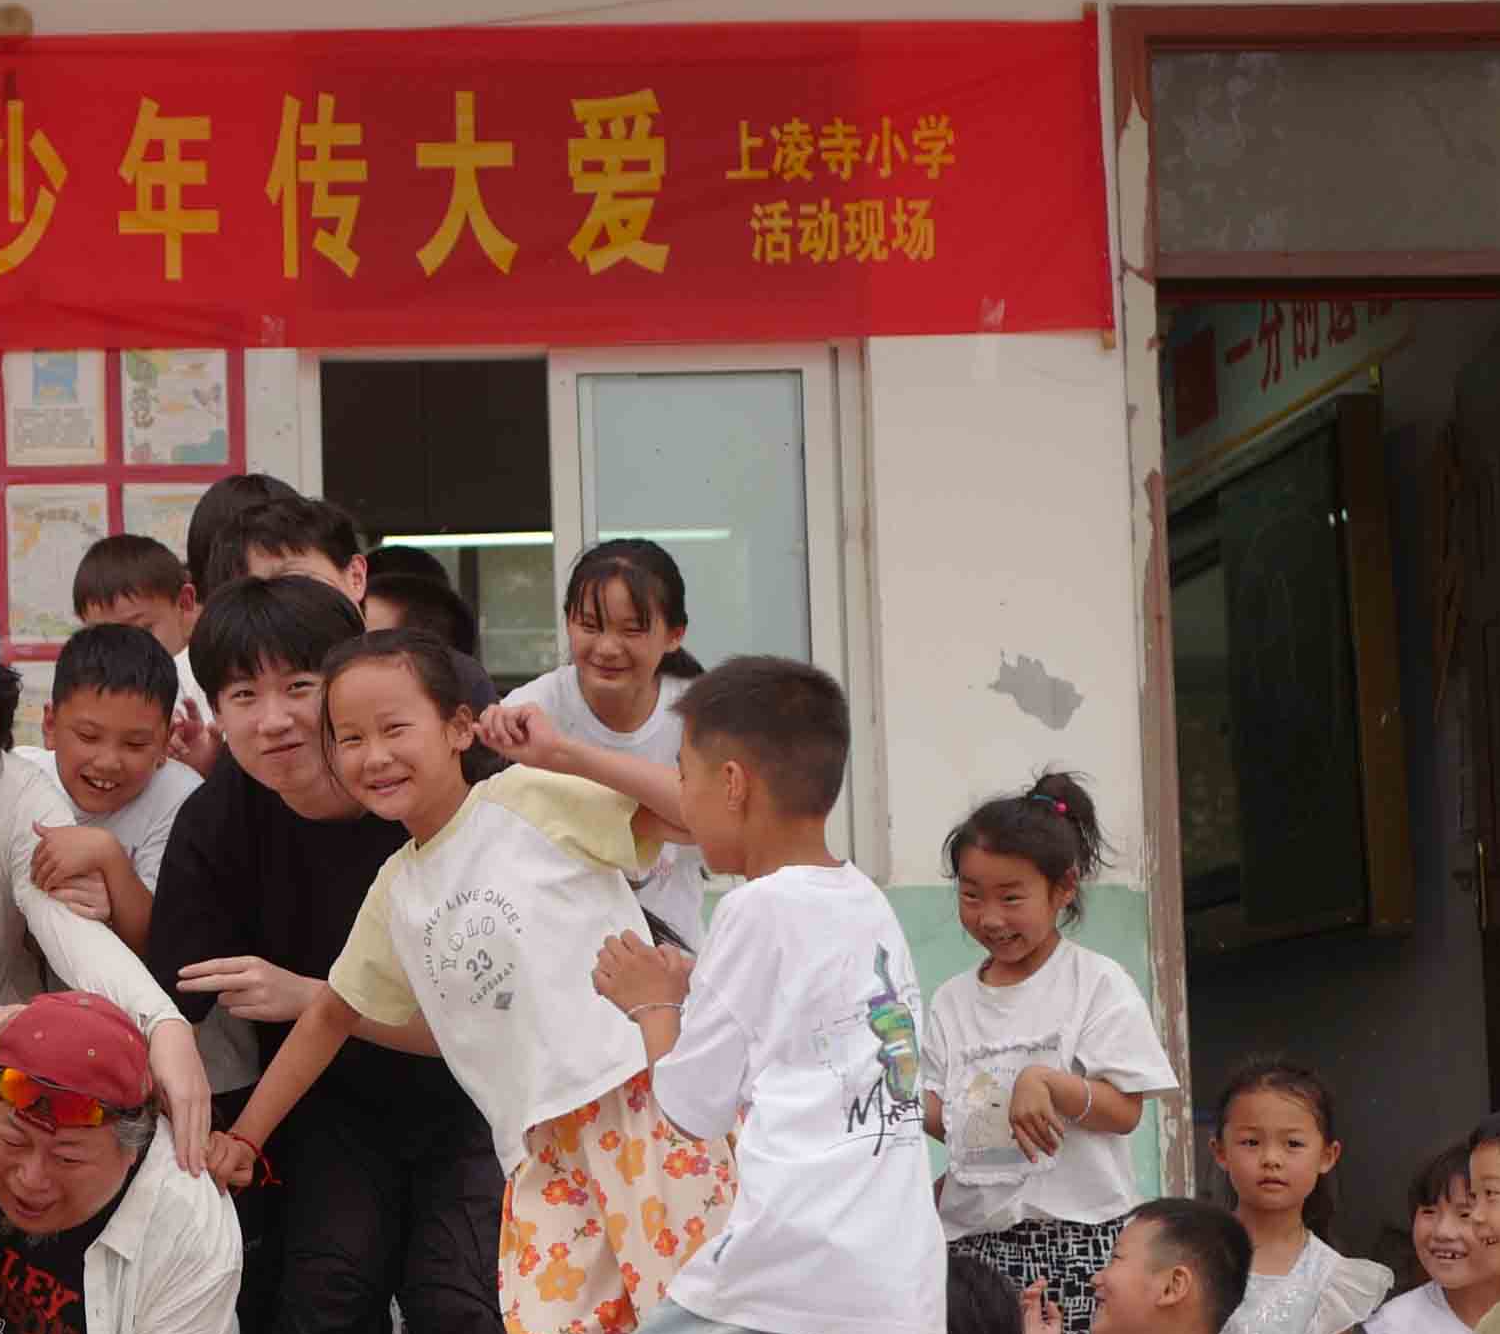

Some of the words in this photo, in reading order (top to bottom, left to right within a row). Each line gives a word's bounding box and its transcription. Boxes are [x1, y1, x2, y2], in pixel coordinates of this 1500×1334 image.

[725, 115, 955, 182] 上凌寺小学
[749, 197, 937, 263] 活动现场
[446, 889, 481, 911] LIVE
[483, 889, 520, 925] ONCE
